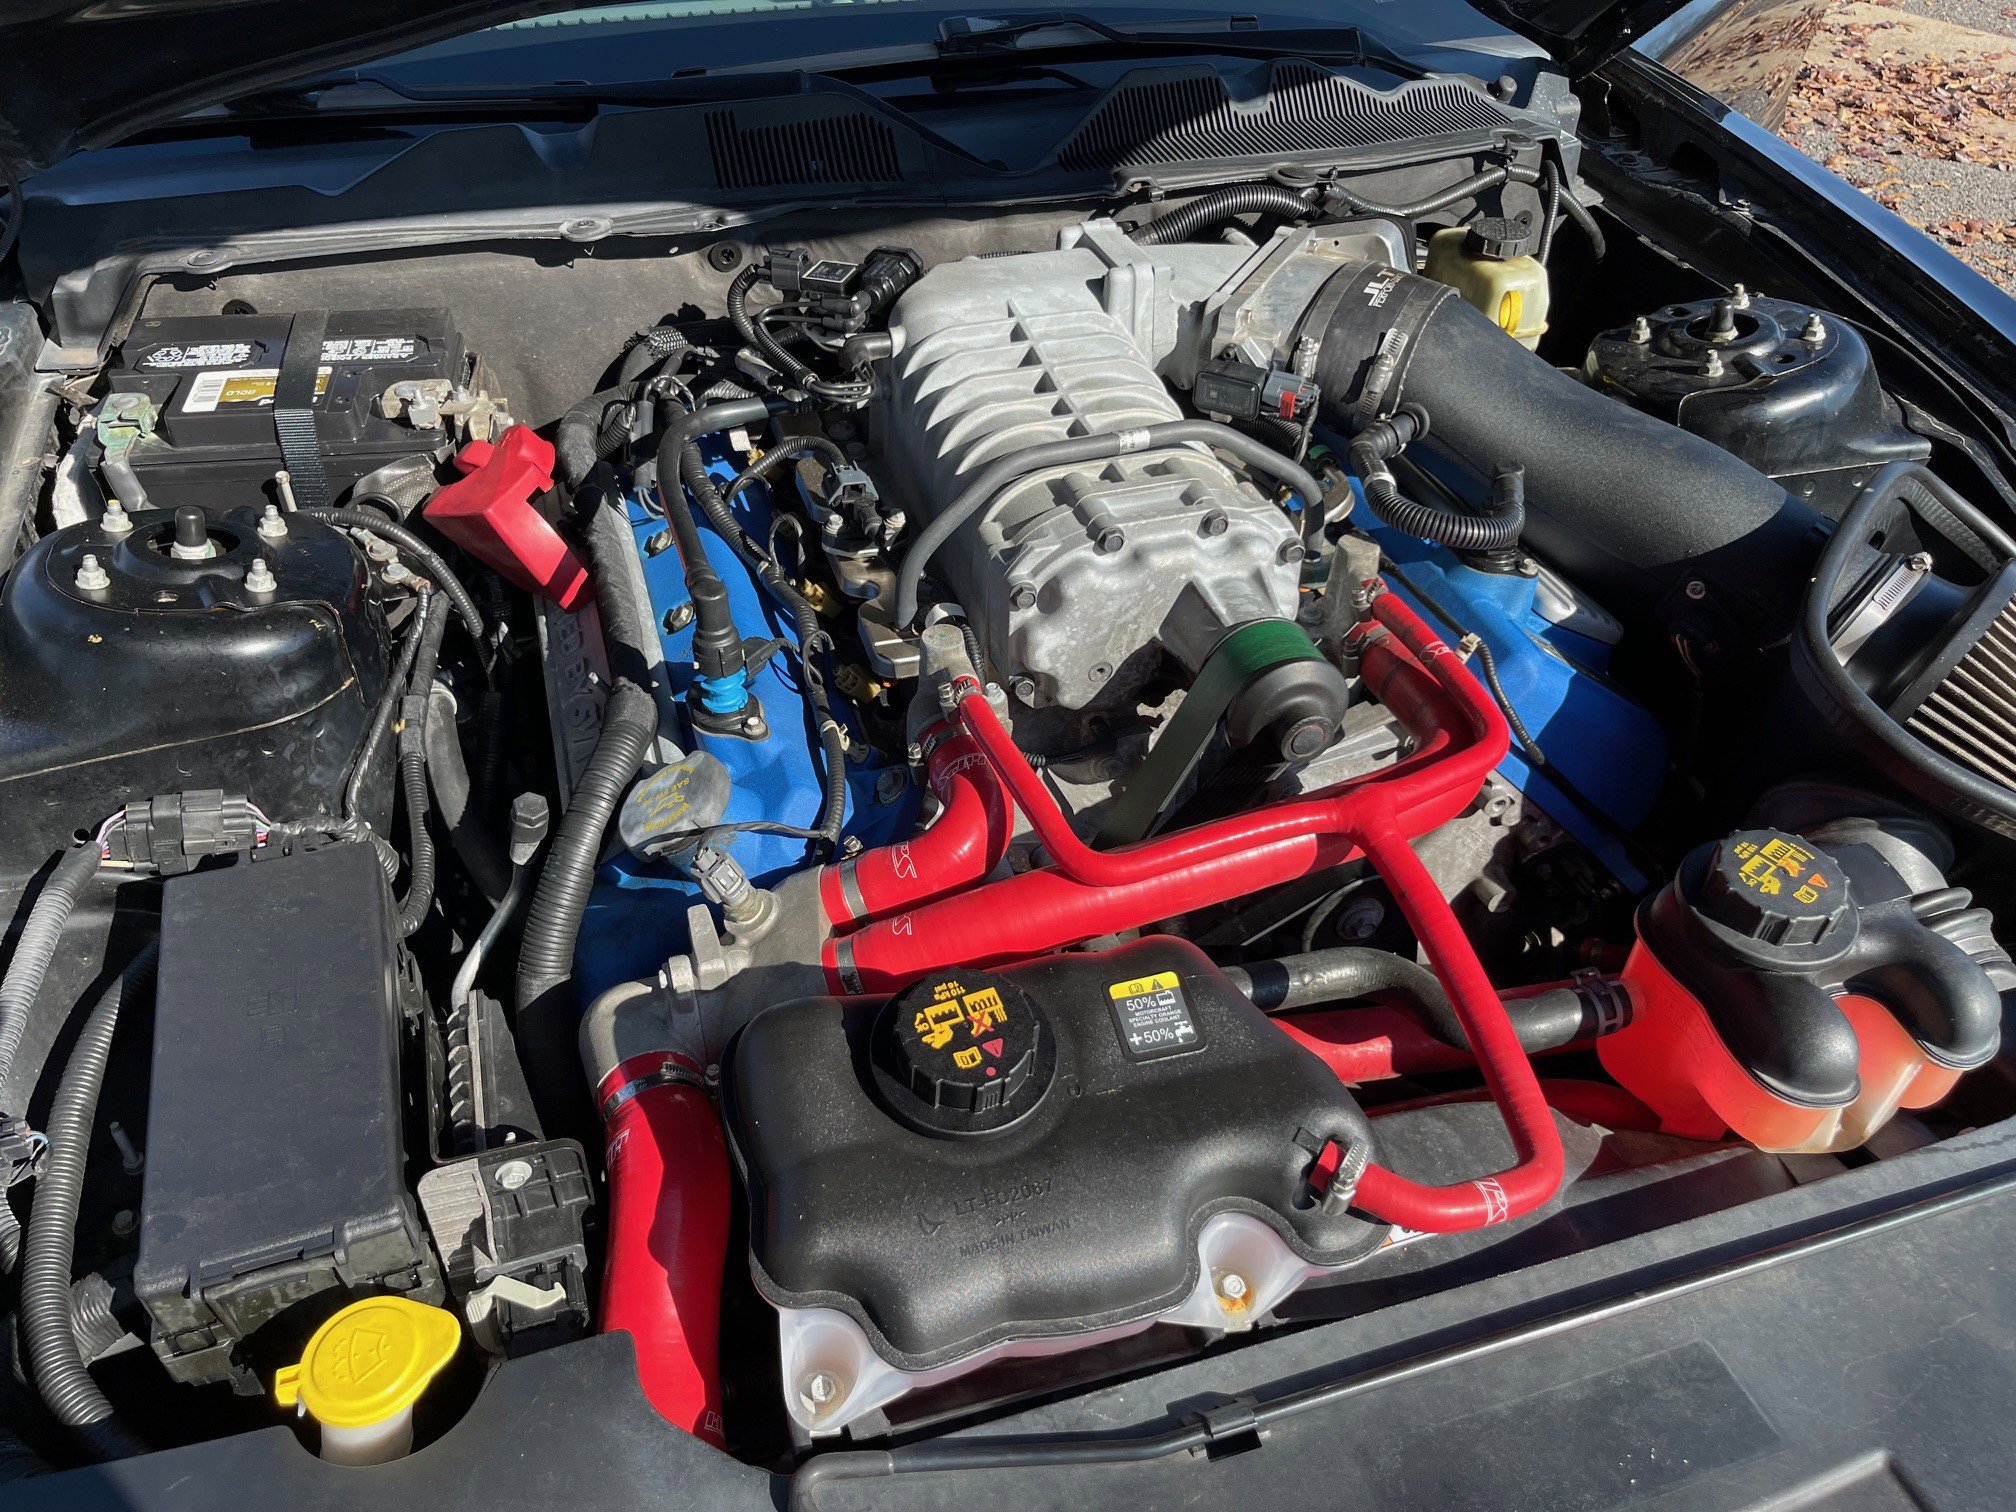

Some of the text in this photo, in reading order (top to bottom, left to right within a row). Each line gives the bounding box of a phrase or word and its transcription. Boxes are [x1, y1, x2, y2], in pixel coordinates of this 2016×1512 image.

[671, 778, 690, 791] SAE
[934, 986, 966, 1001] 110 kPa
[1126, 995, 1156, 1011] 50%
[1135, 1005, 1172, 1016] MOTORCRAFT
[1129, 1009, 1182, 1024] SPECIALTY ORANGE
[1133, 1014, 1181, 1028] ENGINE COOLANT
[1020, 1217, 1071, 1242] TAIWAN
